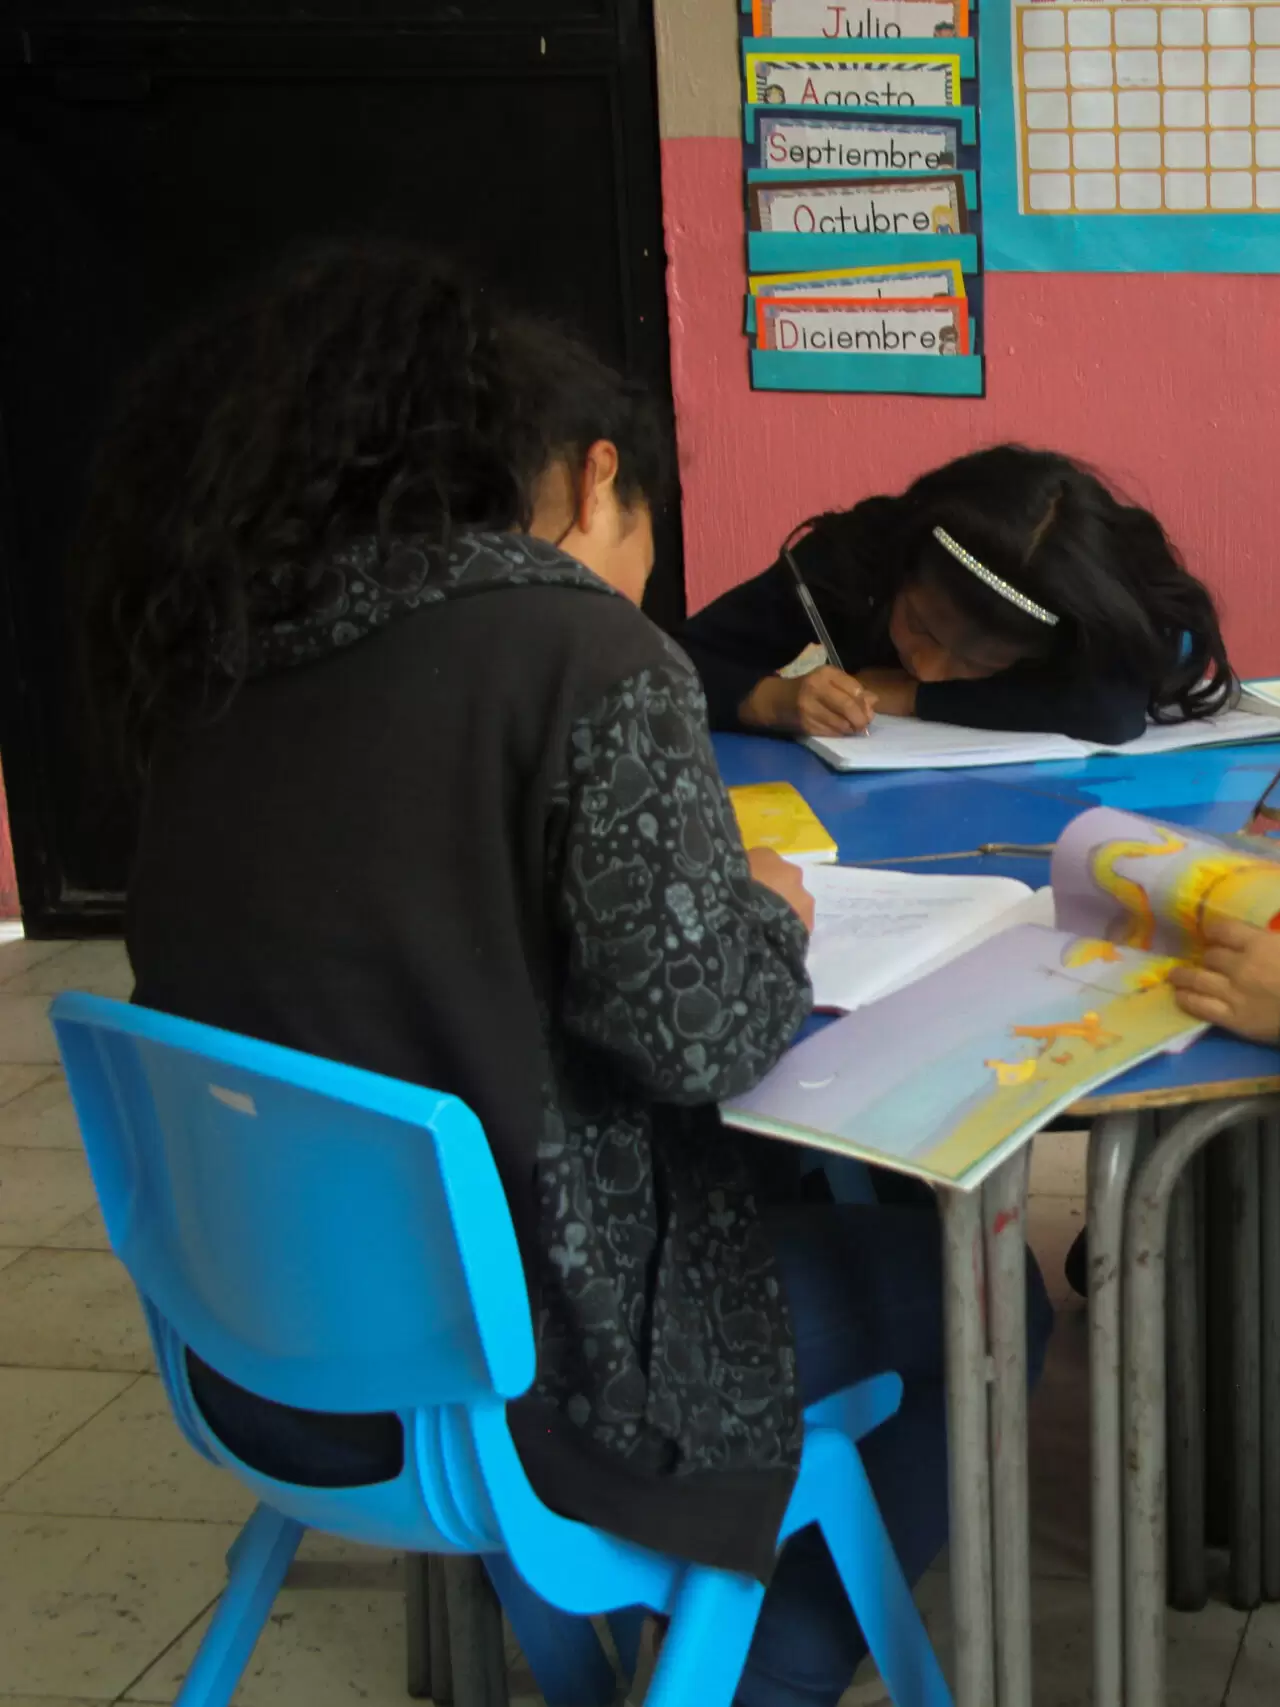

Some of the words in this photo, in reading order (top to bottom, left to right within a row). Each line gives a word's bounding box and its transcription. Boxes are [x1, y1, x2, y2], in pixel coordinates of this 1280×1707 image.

[822, 6, 901, 38] Julio
[770, 132, 940, 168] Septiembre
[794, 200, 930, 234] Octubre
[780, 319, 936, 349] Diciembre
